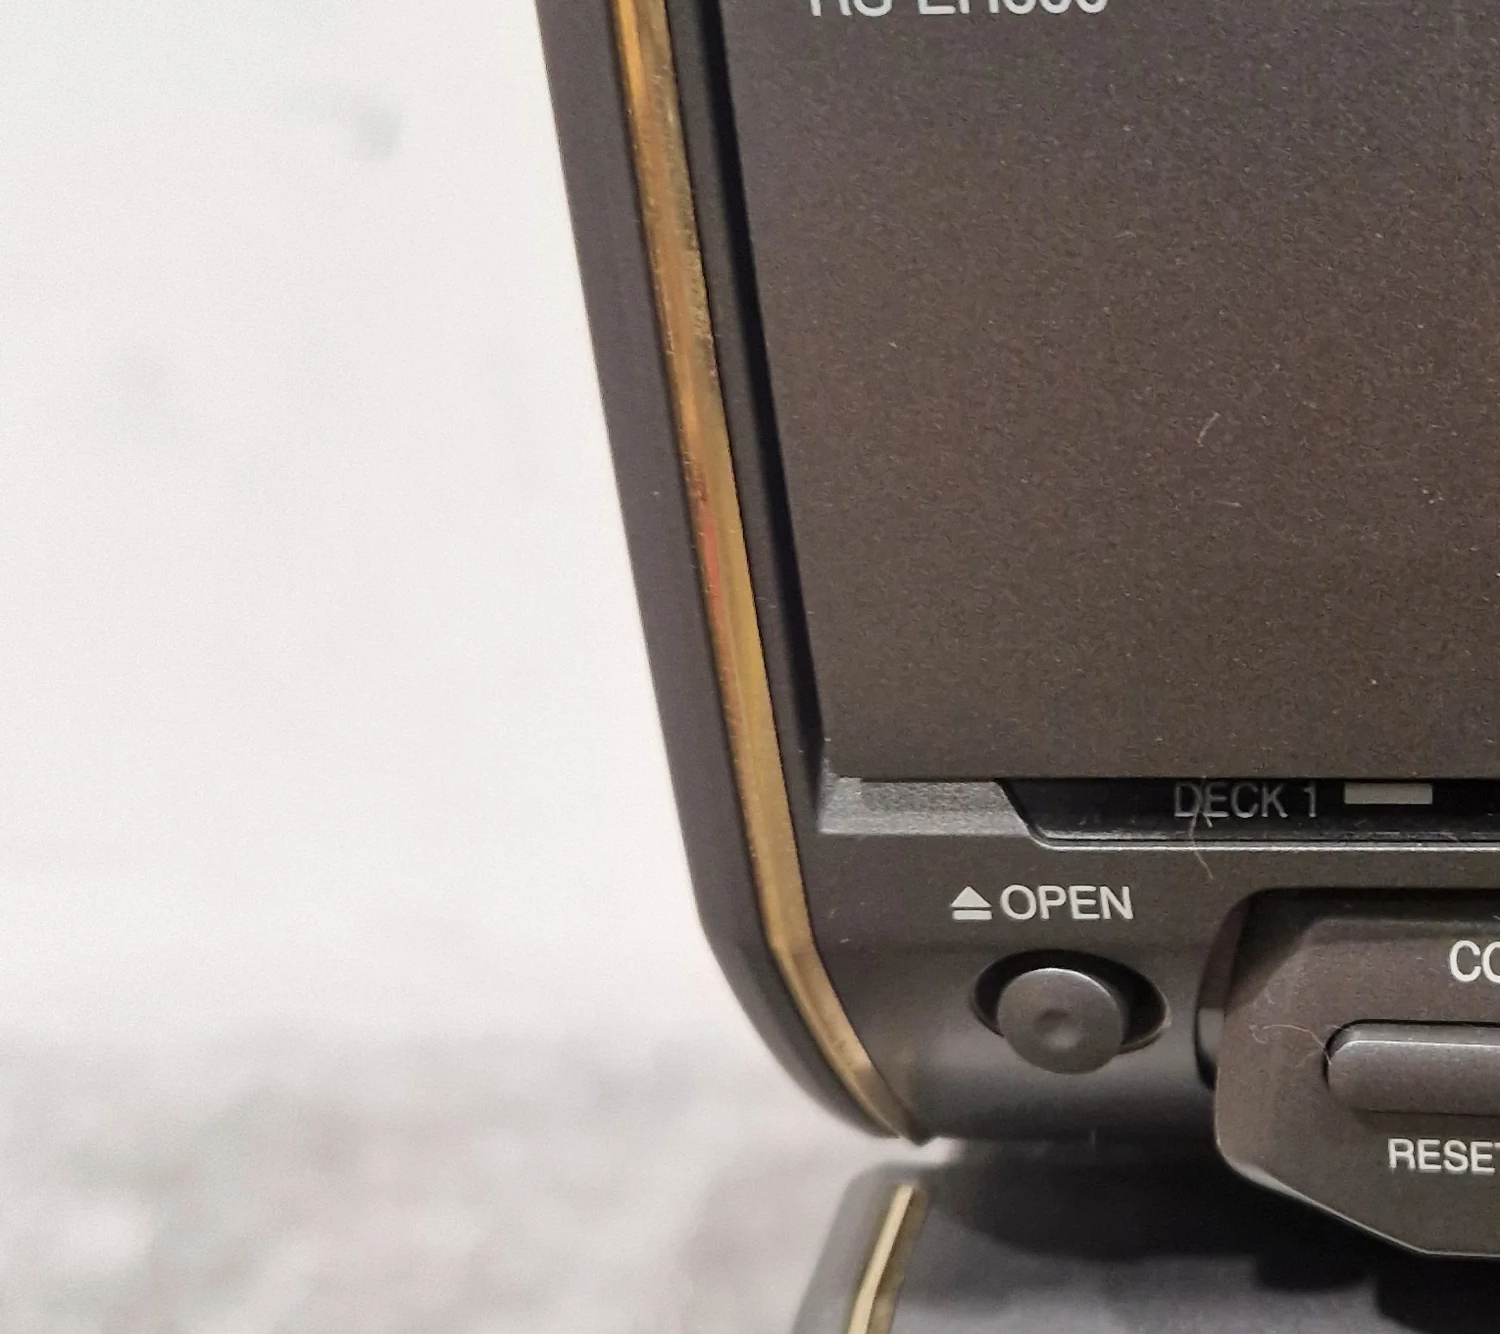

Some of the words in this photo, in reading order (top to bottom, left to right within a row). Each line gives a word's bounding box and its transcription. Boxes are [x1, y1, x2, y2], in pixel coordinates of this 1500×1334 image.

[1174, 780, 1288, 818] DECK
[1303, 782, 1317, 818] 1
[1001, 884, 1134, 923] OPEN
